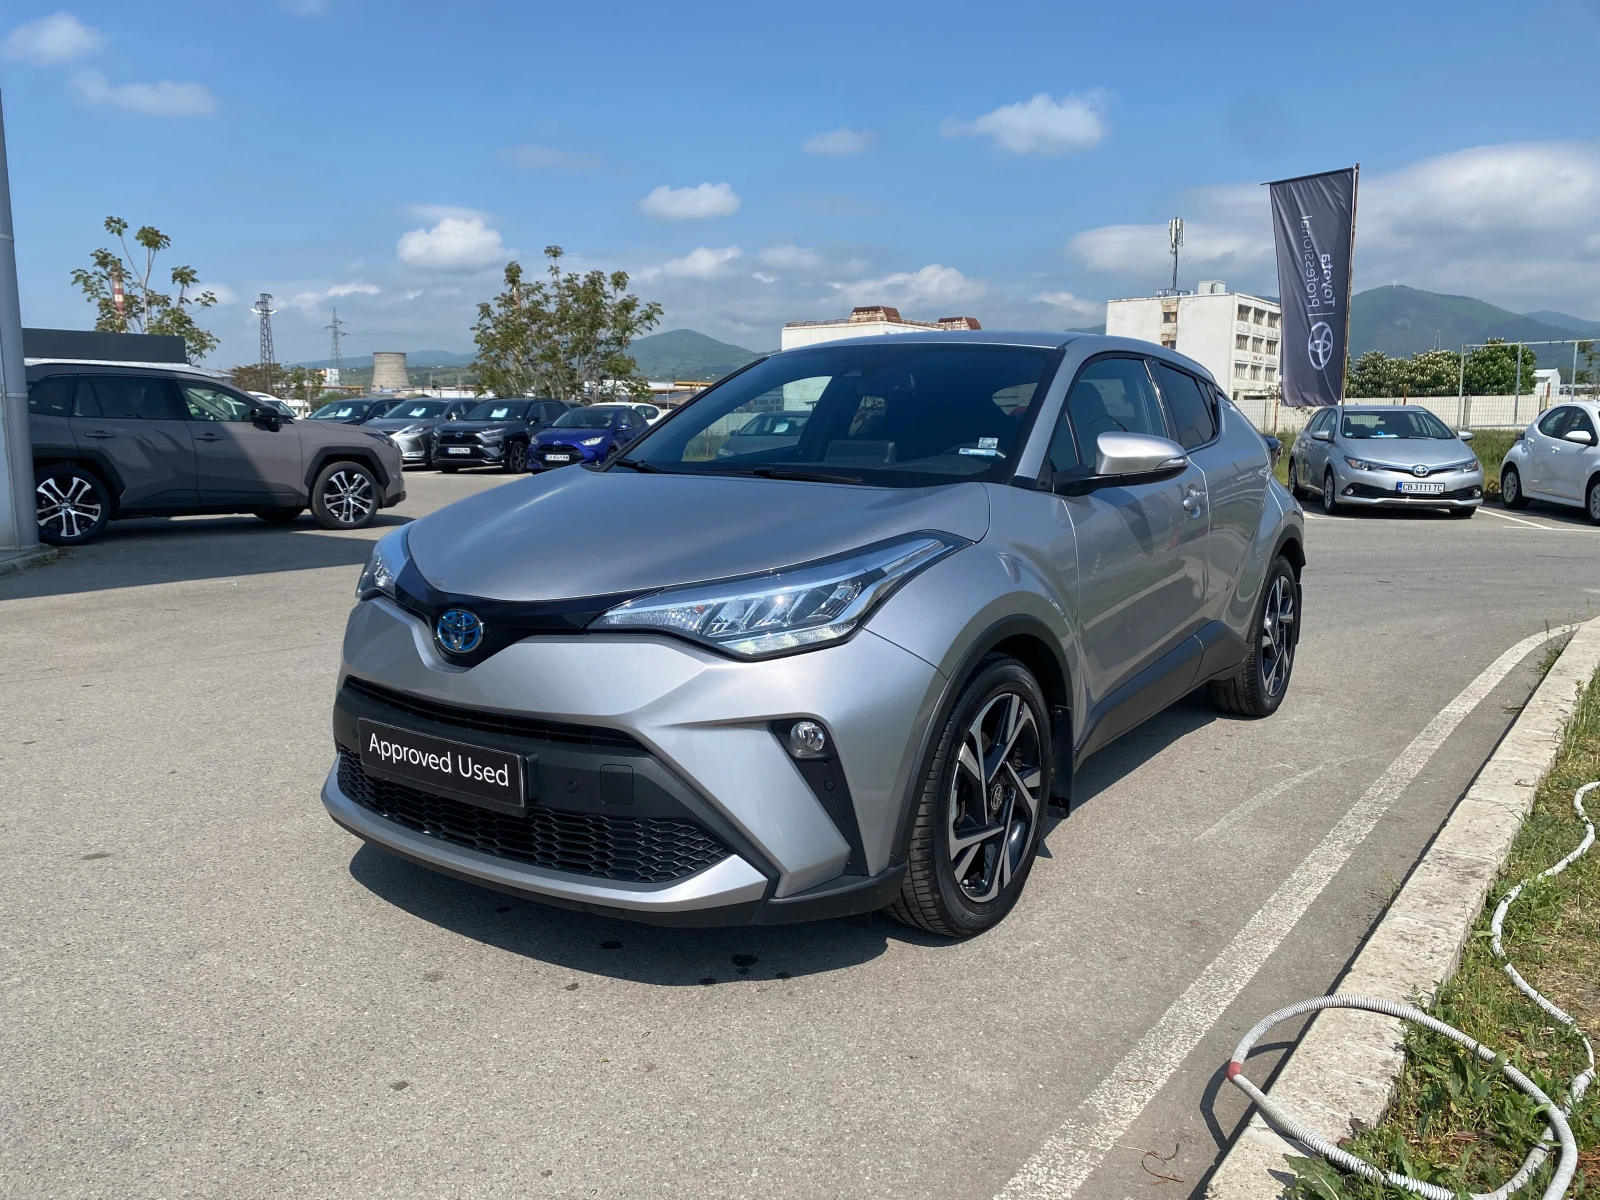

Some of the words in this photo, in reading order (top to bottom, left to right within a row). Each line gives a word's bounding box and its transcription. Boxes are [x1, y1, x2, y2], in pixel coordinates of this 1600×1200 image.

[1433, 484, 1443, 492] TC
[369, 732, 452, 773] Approved
[457, 754, 509, 786] Used
